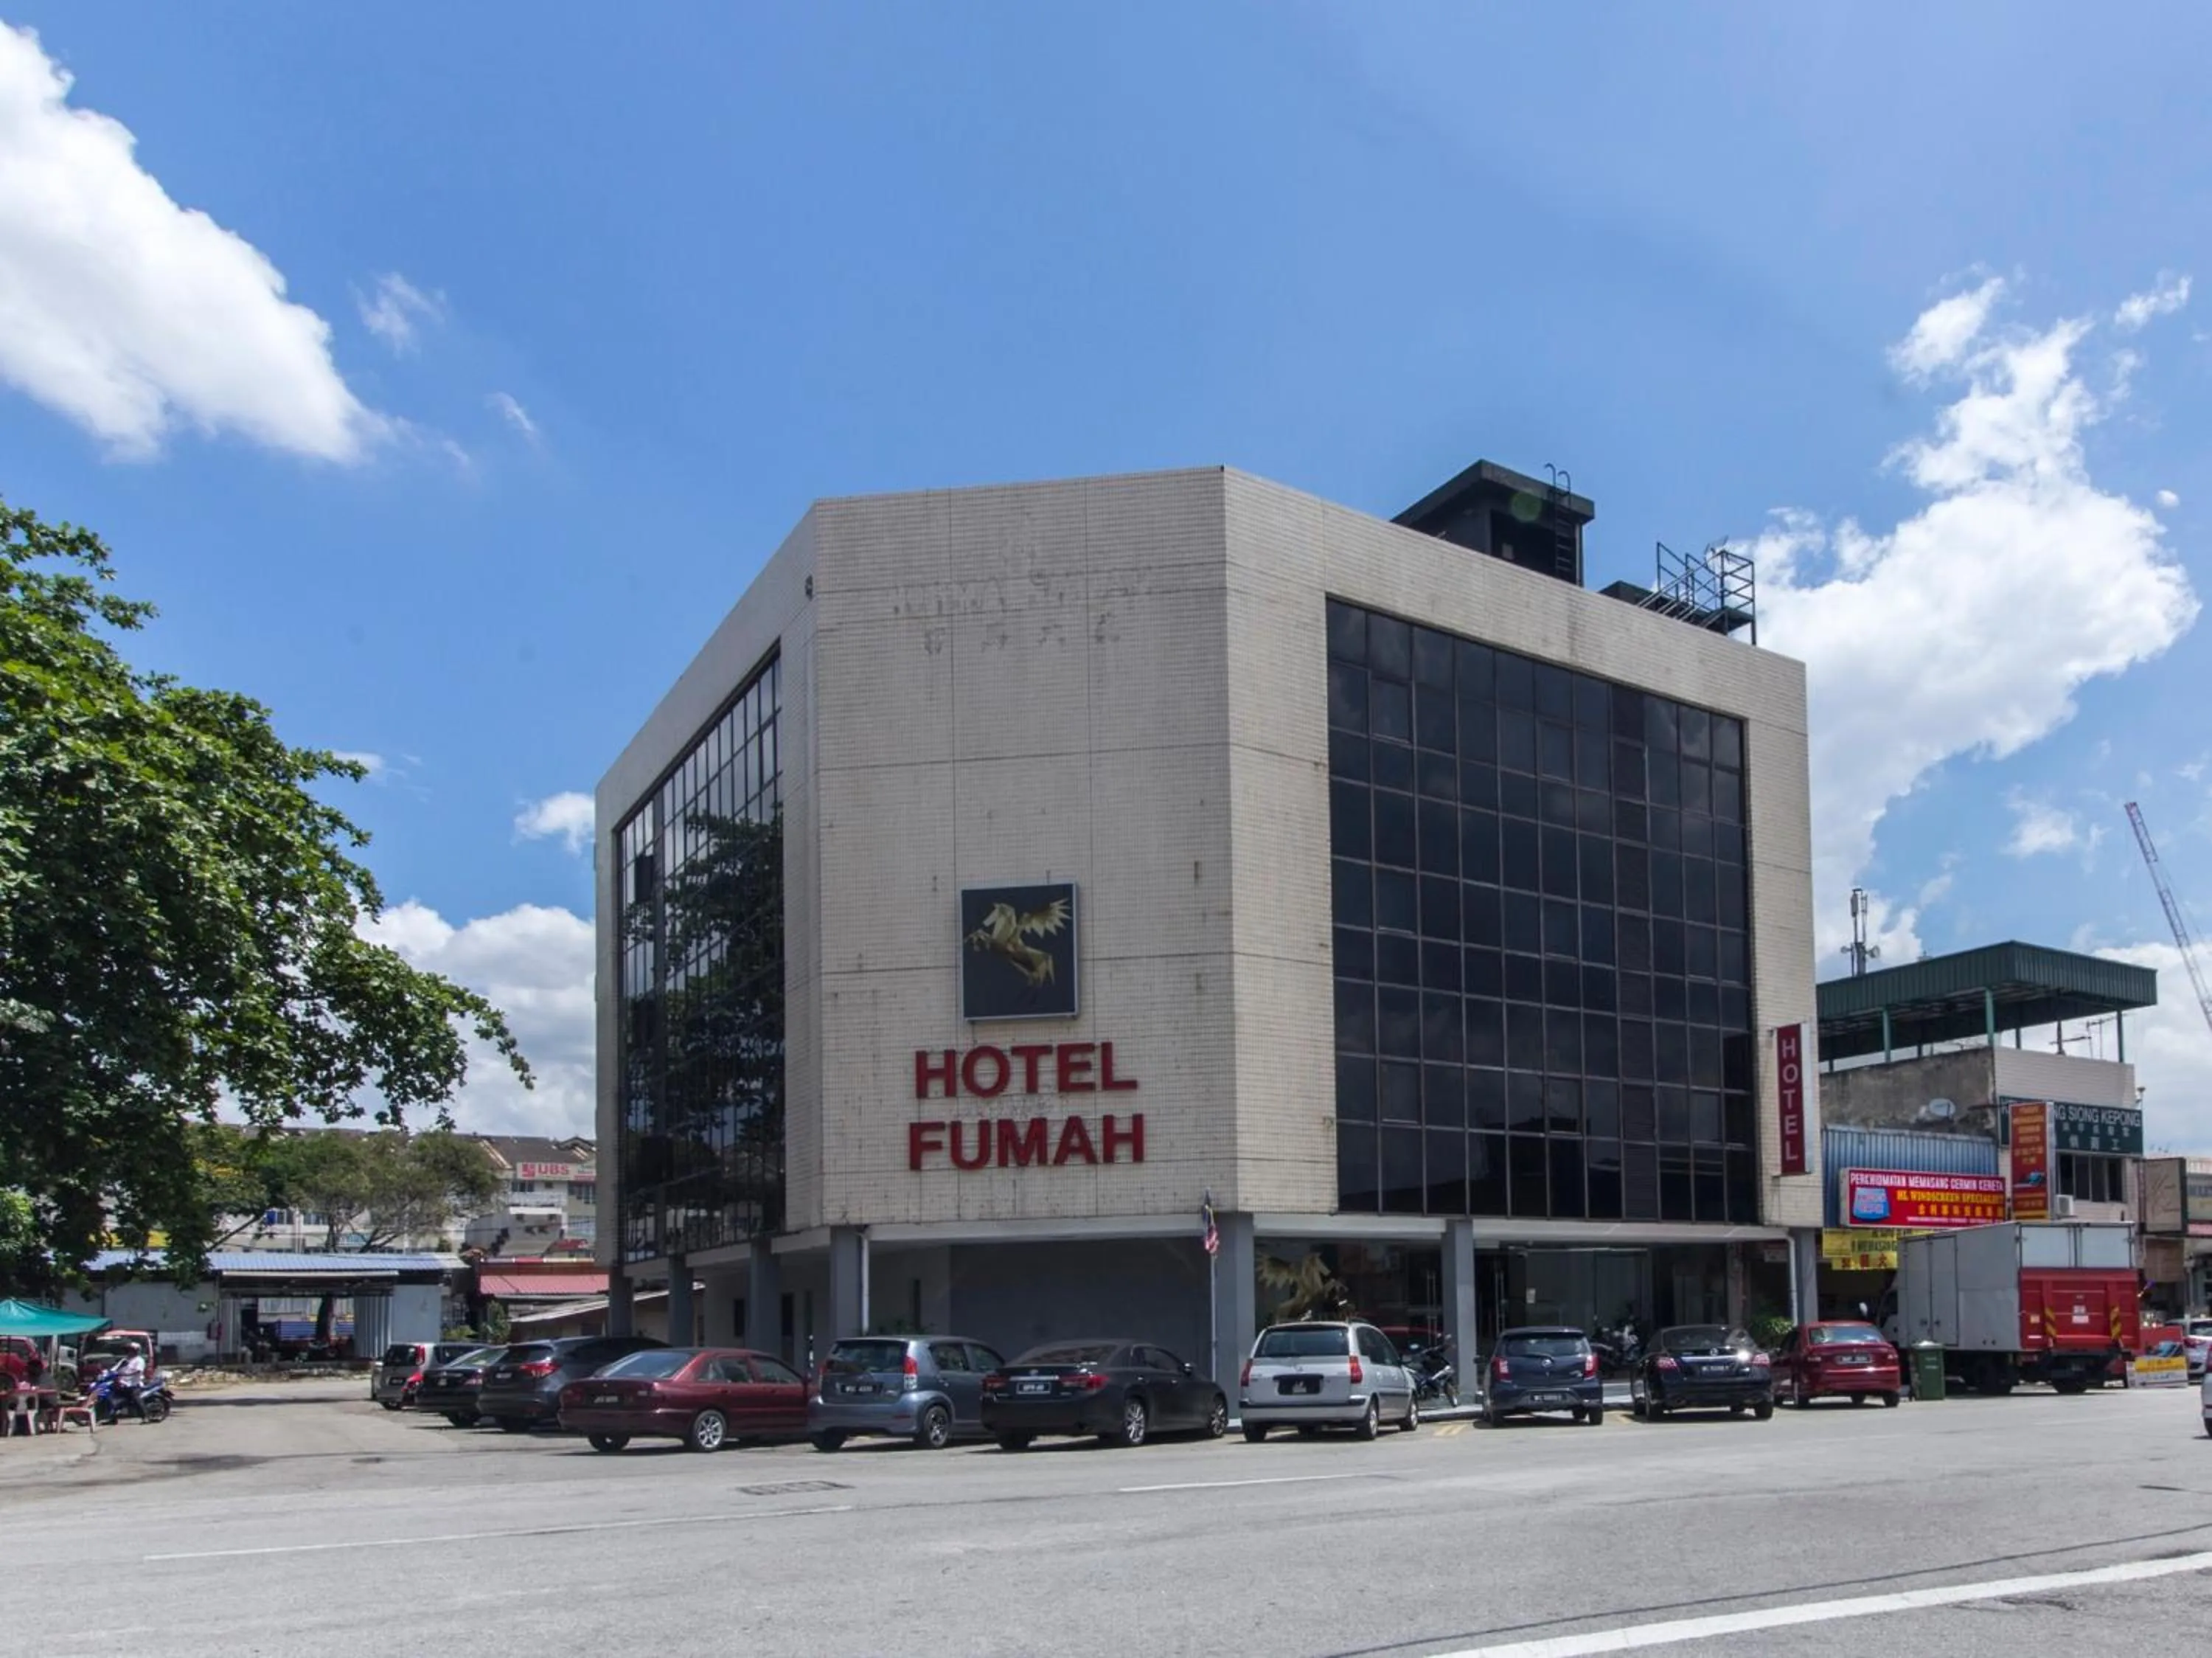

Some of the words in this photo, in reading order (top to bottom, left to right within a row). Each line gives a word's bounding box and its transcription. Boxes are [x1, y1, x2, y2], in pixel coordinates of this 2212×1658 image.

[916, 1042, 1138, 1099] HOTEL
[1781, 1038, 1799, 1161] HOTEL
[2068, 1106, 2100, 1123] SIONG
[2101, 1109, 2141, 1127] KEPONG
[538, 1163, 570, 1176] UBS
[909, 1114, 1144, 1170] FUMAH
